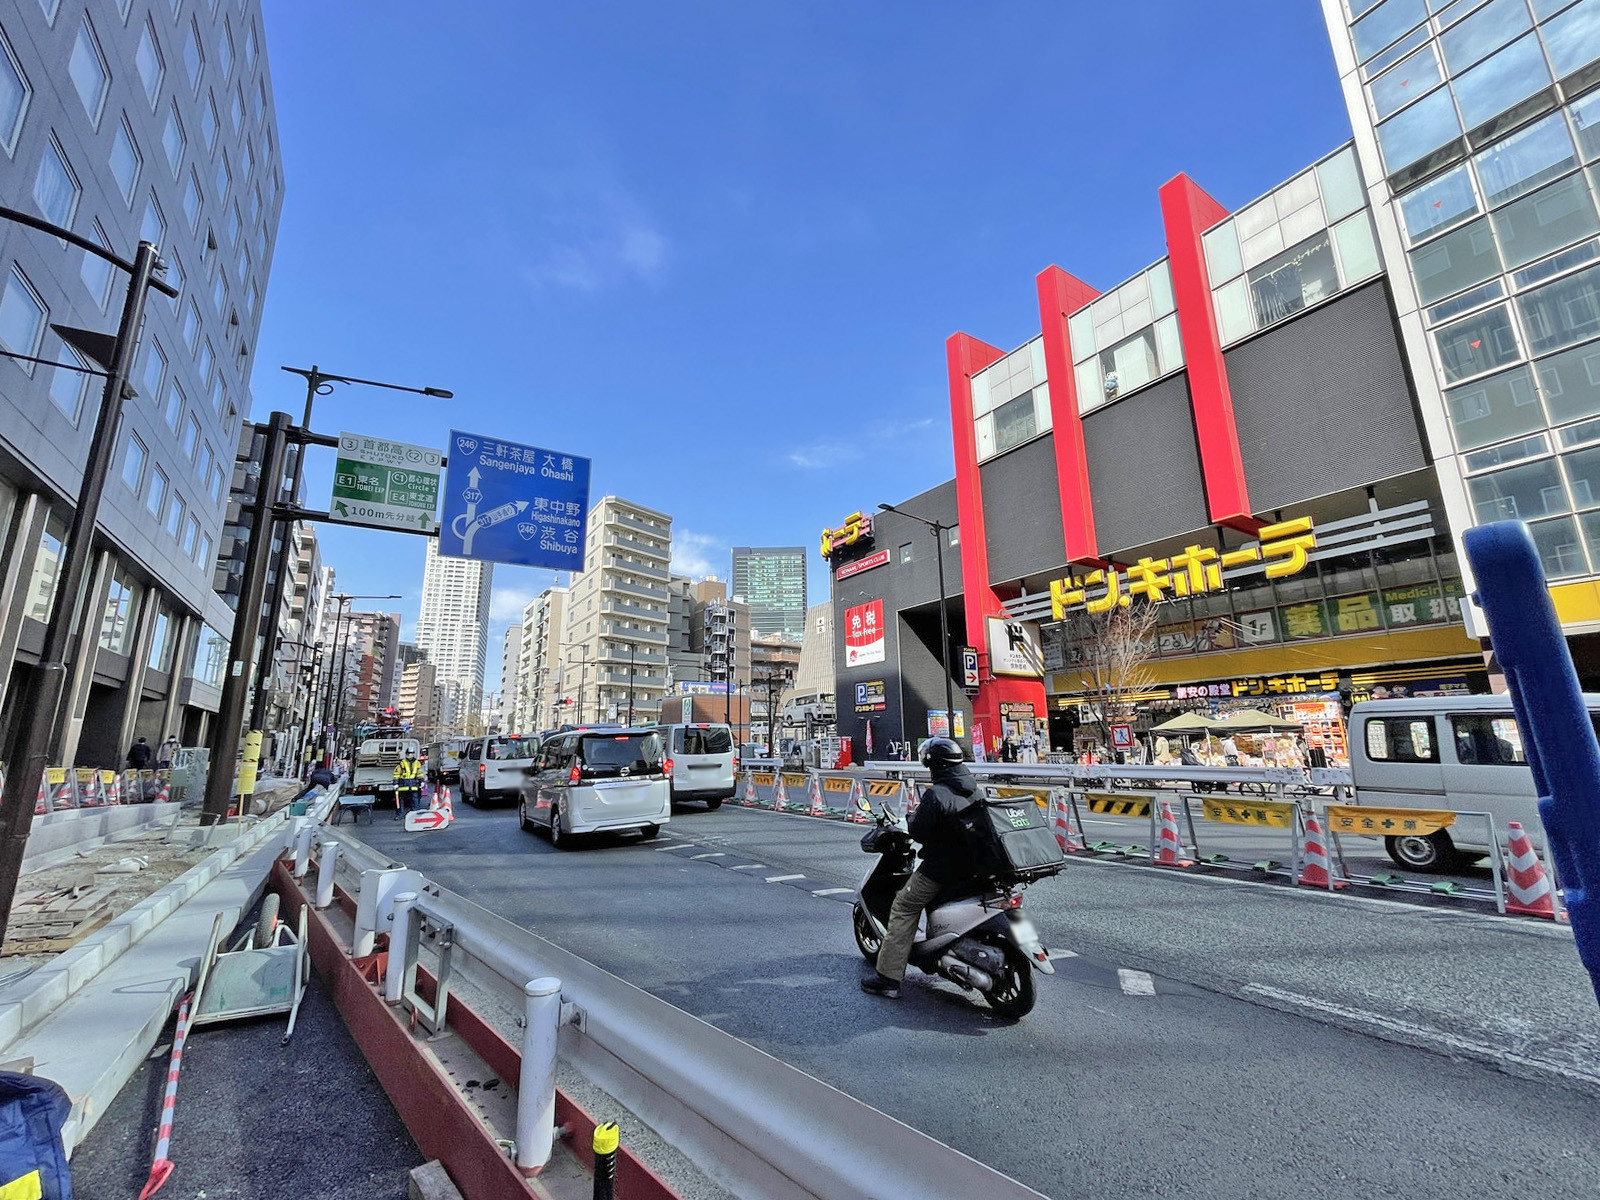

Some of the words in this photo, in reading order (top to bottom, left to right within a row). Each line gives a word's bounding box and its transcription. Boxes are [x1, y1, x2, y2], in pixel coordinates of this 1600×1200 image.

[363, 439, 404, 456] 首都高
[459, 438, 475, 450] 246
[359, 449, 405, 462] SHUTOKO
[480, 440, 536, 465] 三軒茶屋
[542, 453, 574, 472] 大橋
[479, 455, 536, 476] Sangenjaya
[540, 466, 574, 482] Ohashi
[338, 475, 353, 486] E1
[356, 483, 374, 493] TOMEI
[357, 474, 380, 487] 東名
[407, 473, 439, 488] 都心環状
[407, 483, 430, 492] Circle
[391, 492, 406, 503] E4
[408, 492, 434, 504] 東北道
[465, 491, 480, 501] 317
[532, 496, 581, 517] 東中野
[479, 516, 491, 527] 317
[530, 510, 581, 528] Higashinakano
[519, 525, 535, 535] 246
[540, 525, 579, 544] 渋谷
[539, 539, 578, 555] Shibuya
[857, 558, 874, 570] SPORTS
[873, 554, 886, 564] CLUB
[1384, 583, 1456, 604] Medicine
[851, 609, 876, 630] 免税
[966, 655, 975, 670] P
[857, 685, 866, 703] P
[1176, 683, 1232, 700] 驚安の殿堂
[1006, 808, 1026, 818] Uber
[1010, 818, 1031, 828] Eats
